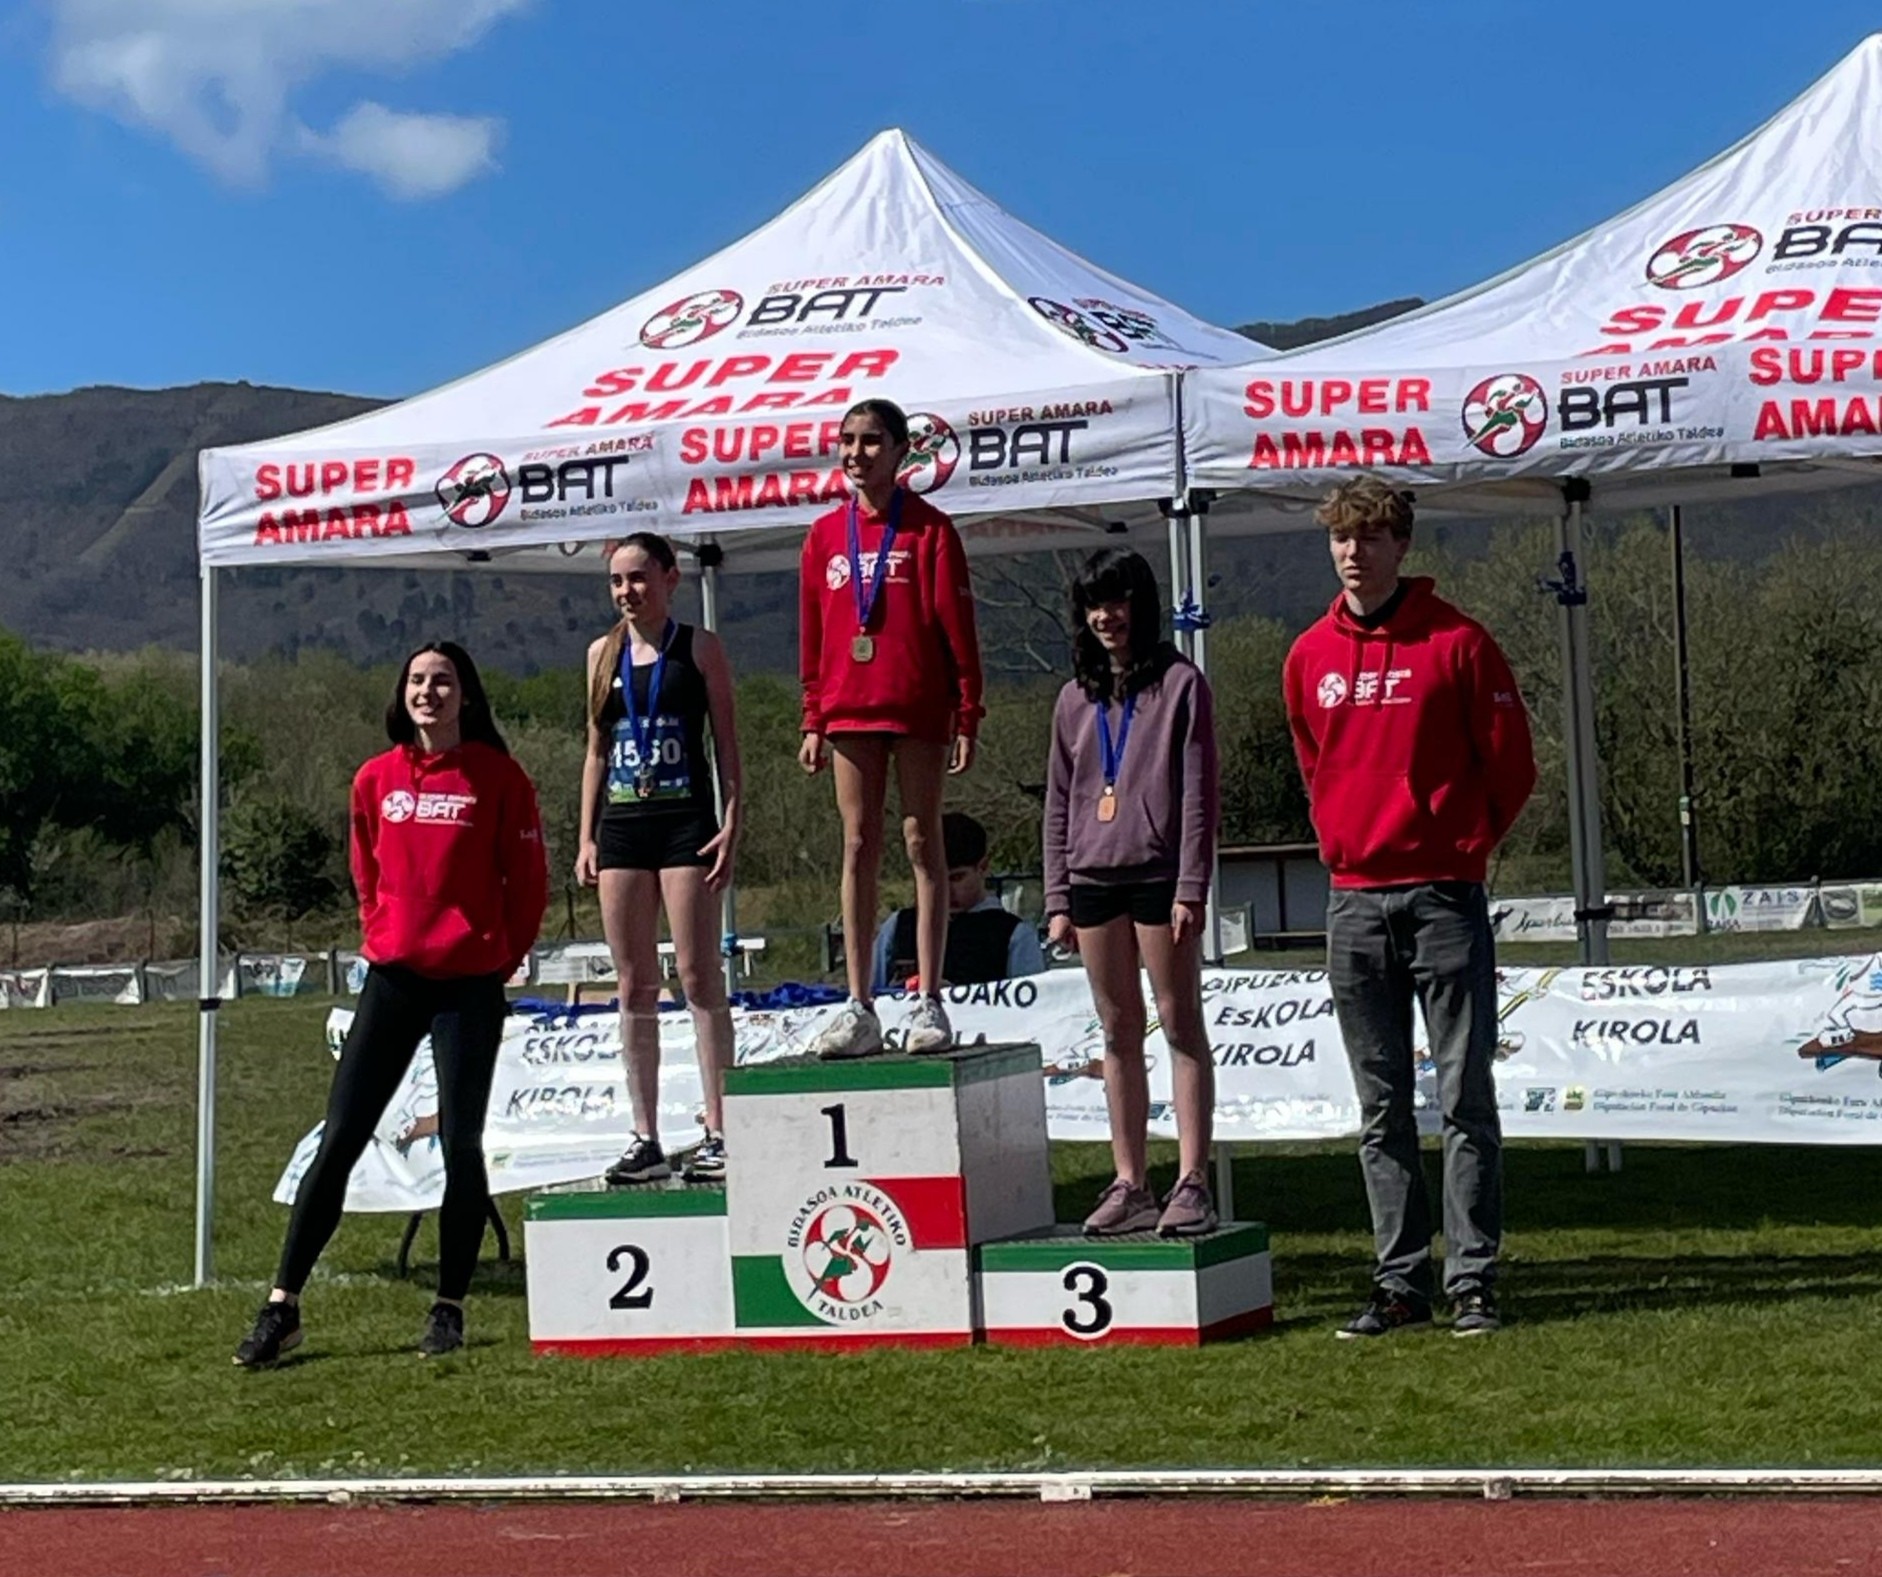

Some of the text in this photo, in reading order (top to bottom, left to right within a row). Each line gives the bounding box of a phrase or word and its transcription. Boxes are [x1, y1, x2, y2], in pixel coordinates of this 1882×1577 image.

[1785, 207, 1882, 226] SUPER
[1772, 222, 1882, 261] BA
[766, 274, 944, 295] SUPER AMARA
[746, 286, 907, 327] BAT
[582, 349, 899, 398] SUPER
[1561, 356, 1717, 385] SUPER AMARA
[1748, 348, 1882, 386] SUP
[546, 387, 852, 428] AMARA
[968, 400, 1113, 426] SUPER AMARA
[1244, 378, 1431, 418] SUPER
[1558, 377, 1690, 431] BAT
[1753, 397, 1882, 441] AMA
[585, 431, 656, 455] AMARA
[969, 420, 1089, 470] BAT
[1249, 427, 1432, 469] AMARA
[255, 457, 415, 501] SUPER
[518, 454, 629, 504] BAT
[682, 467, 850, 515] AMARA
[254, 499, 412, 547] AMARA
[416, 801, 466, 820] BAT
[1582, 967, 1711, 1000] ESKOLA
[1214, 998, 1335, 1028] ESKOLA
[1573, 1019, 1700, 1047] KIROLA
[523, 1032, 619, 1064] ESKOL
[821, 1103, 859, 1168] 1
[788, 1185, 906, 1248] BIDASOA ATLETIKO
[606, 1244, 654, 1310] 2
[818, 1300, 884, 1321] TALDEA
[1062, 1266, 1113, 1334] 3
